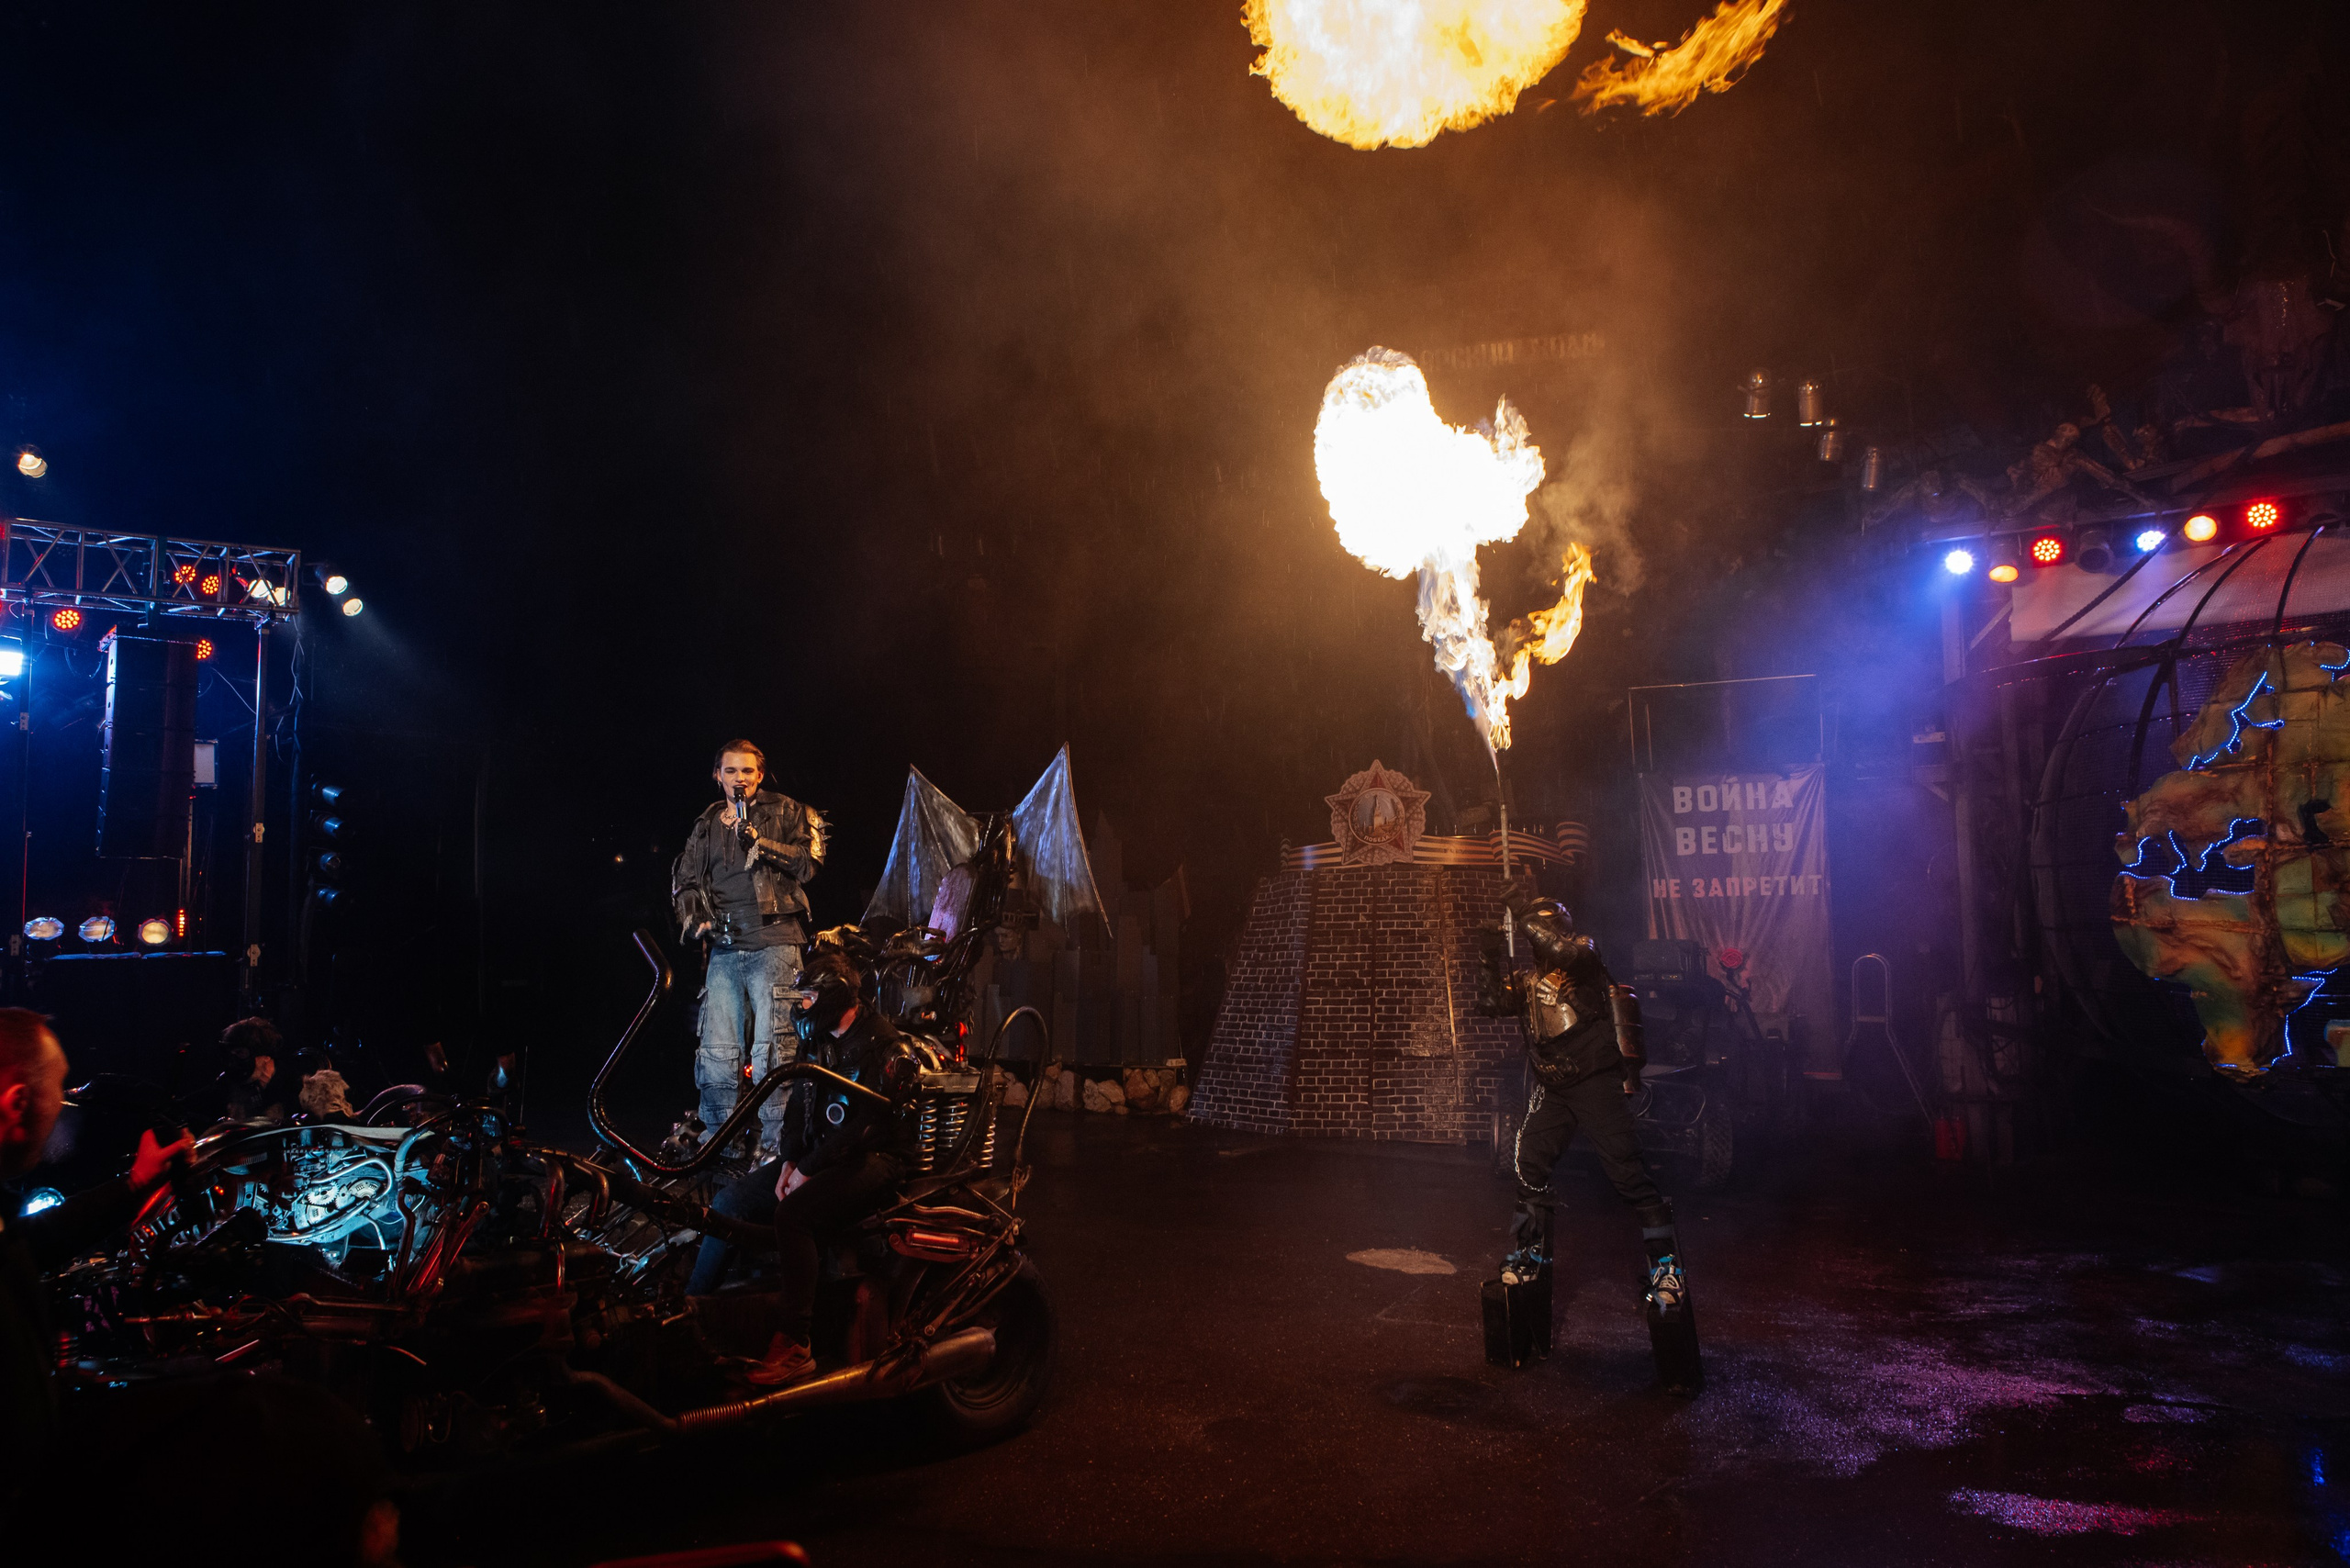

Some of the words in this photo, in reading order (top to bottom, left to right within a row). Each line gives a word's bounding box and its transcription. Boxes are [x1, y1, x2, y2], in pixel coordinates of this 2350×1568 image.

[1673, 777, 1794, 813] ВОЙНА
[1363, 834, 1391, 843] ПОБЕДА
[1675, 823, 1794, 856] ВЕСНУ
[1653, 879, 1681, 898] НЕ
[1692, 875, 1821, 898] ЗАПРЕТИТ
